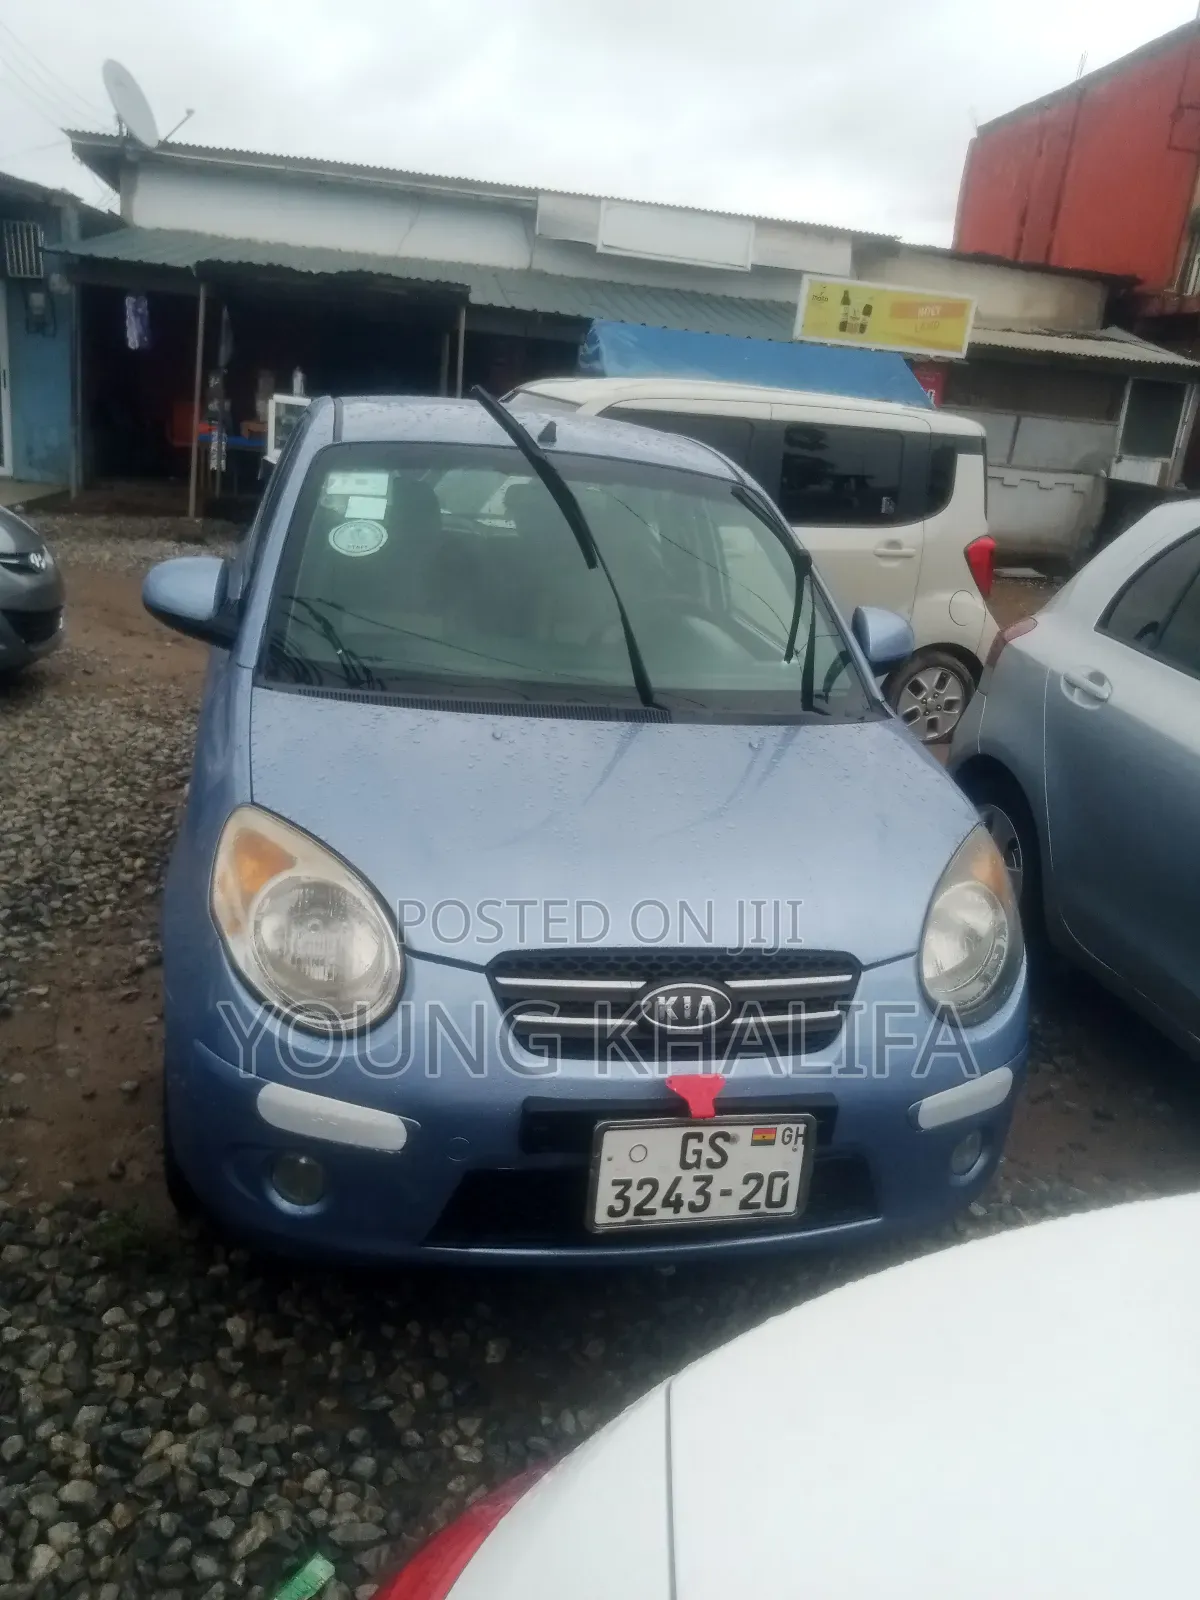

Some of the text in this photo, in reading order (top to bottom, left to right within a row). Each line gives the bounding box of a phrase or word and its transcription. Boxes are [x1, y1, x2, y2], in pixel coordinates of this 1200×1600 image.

[656, 995, 717, 1020] KIA
[679, 1131, 731, 1170] GS
[606, 1170, 790, 1218] 3243-20
